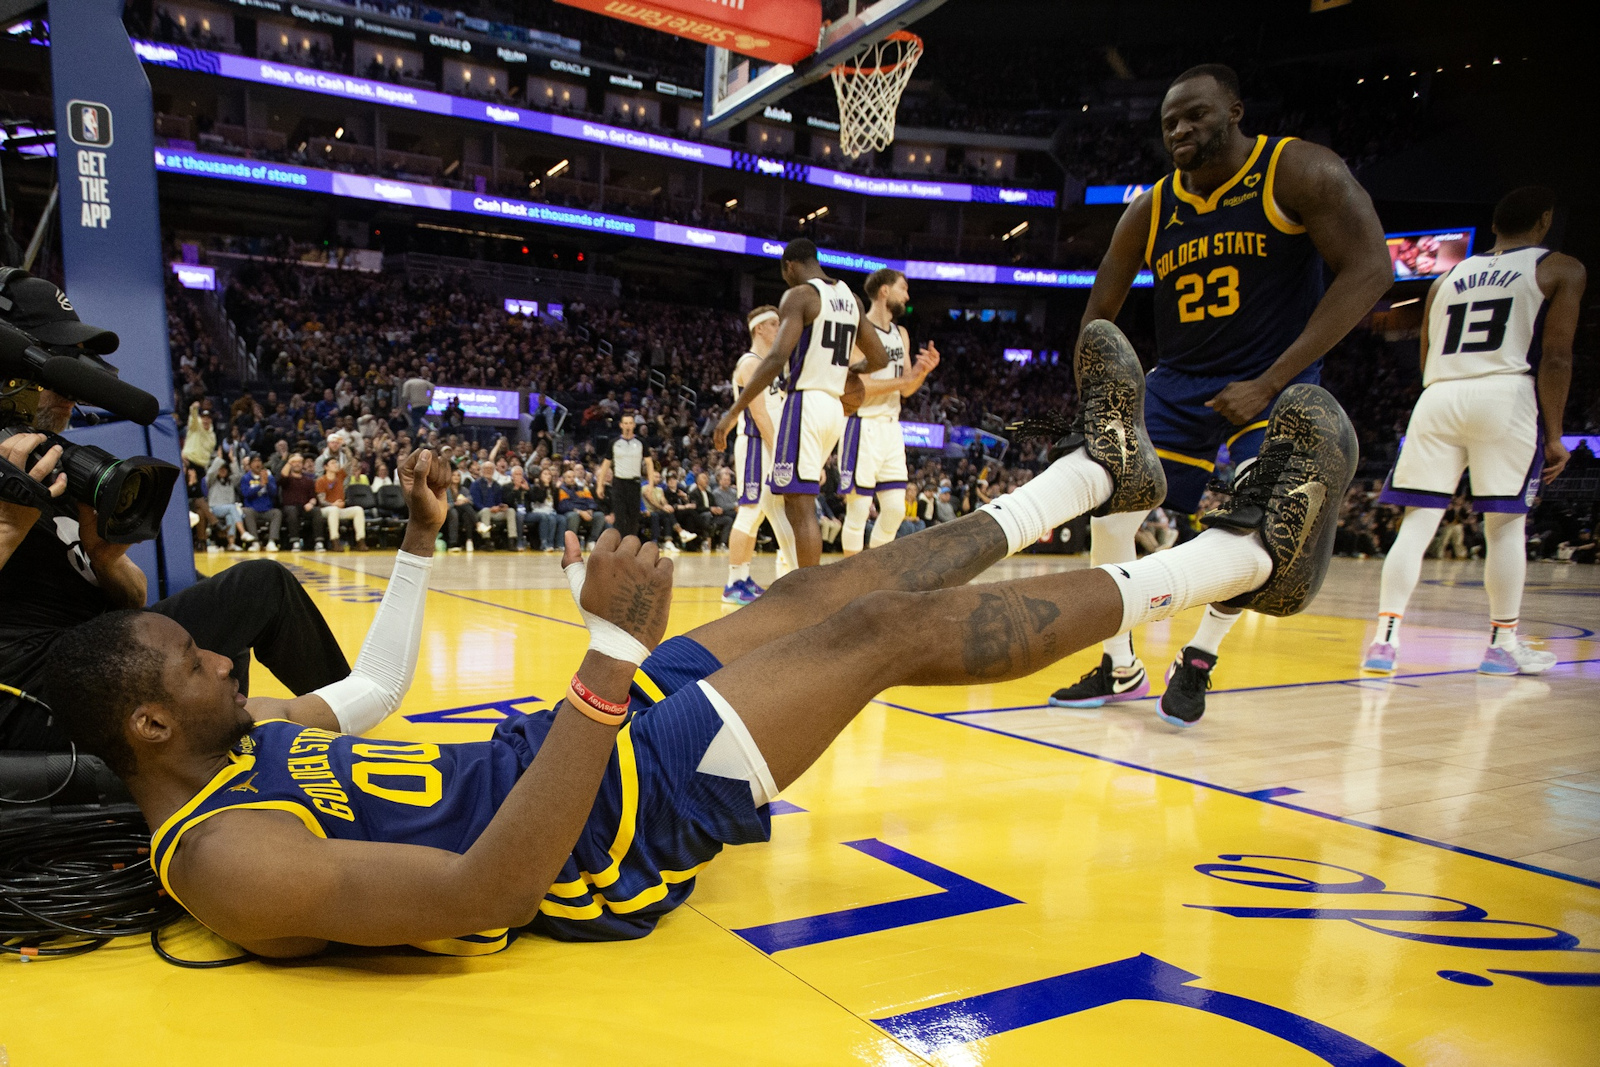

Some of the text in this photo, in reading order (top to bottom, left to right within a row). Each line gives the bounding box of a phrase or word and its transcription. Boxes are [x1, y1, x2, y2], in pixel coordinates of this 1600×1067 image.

[291, 4, 344, 26] Google Cloud
[429, 33, 461, 51] CHASE
[550, 59, 591, 77] ORACLE
[260, 64, 417, 105] Shop. Get Cash Back. Repeat.
[763, 106, 792, 123] Adobe
[583, 124, 704, 159] Shop. Get Cash Back. Repeat.
[78, 150, 107, 177] GET
[166, 155, 182, 169] at
[182, 156, 251, 178] thousands
[251, 166, 268, 180] of
[267, 170, 307, 186] stores
[79, 176, 110, 204] THE
[833, 174, 944, 198] Shop. Get Cash Back. Repeat.
[1223, 191, 1258, 207] Rakuten
[81, 202, 111, 229] APP
[473, 197, 636, 233] Cash Back at thousands of stores
[762, 241, 784, 256] Cash
[817, 250, 854, 268] housands
[855, 257, 864, 268] of
[1155, 231, 1268, 281] GOLDEN STATE
[1013, 270, 1036, 282] Cash
[1036, 271, 1058, 283] Back
[1058, 274, 1067, 284] at
[1453, 269, 1522, 295] MURRAY
[1175, 265, 1240, 323] 23
[1441, 297, 1514, 356] 13
[821, 320, 857, 367] 40
[287, 753, 355, 822] GOLDEN
[352, 743, 442, 807] 00
